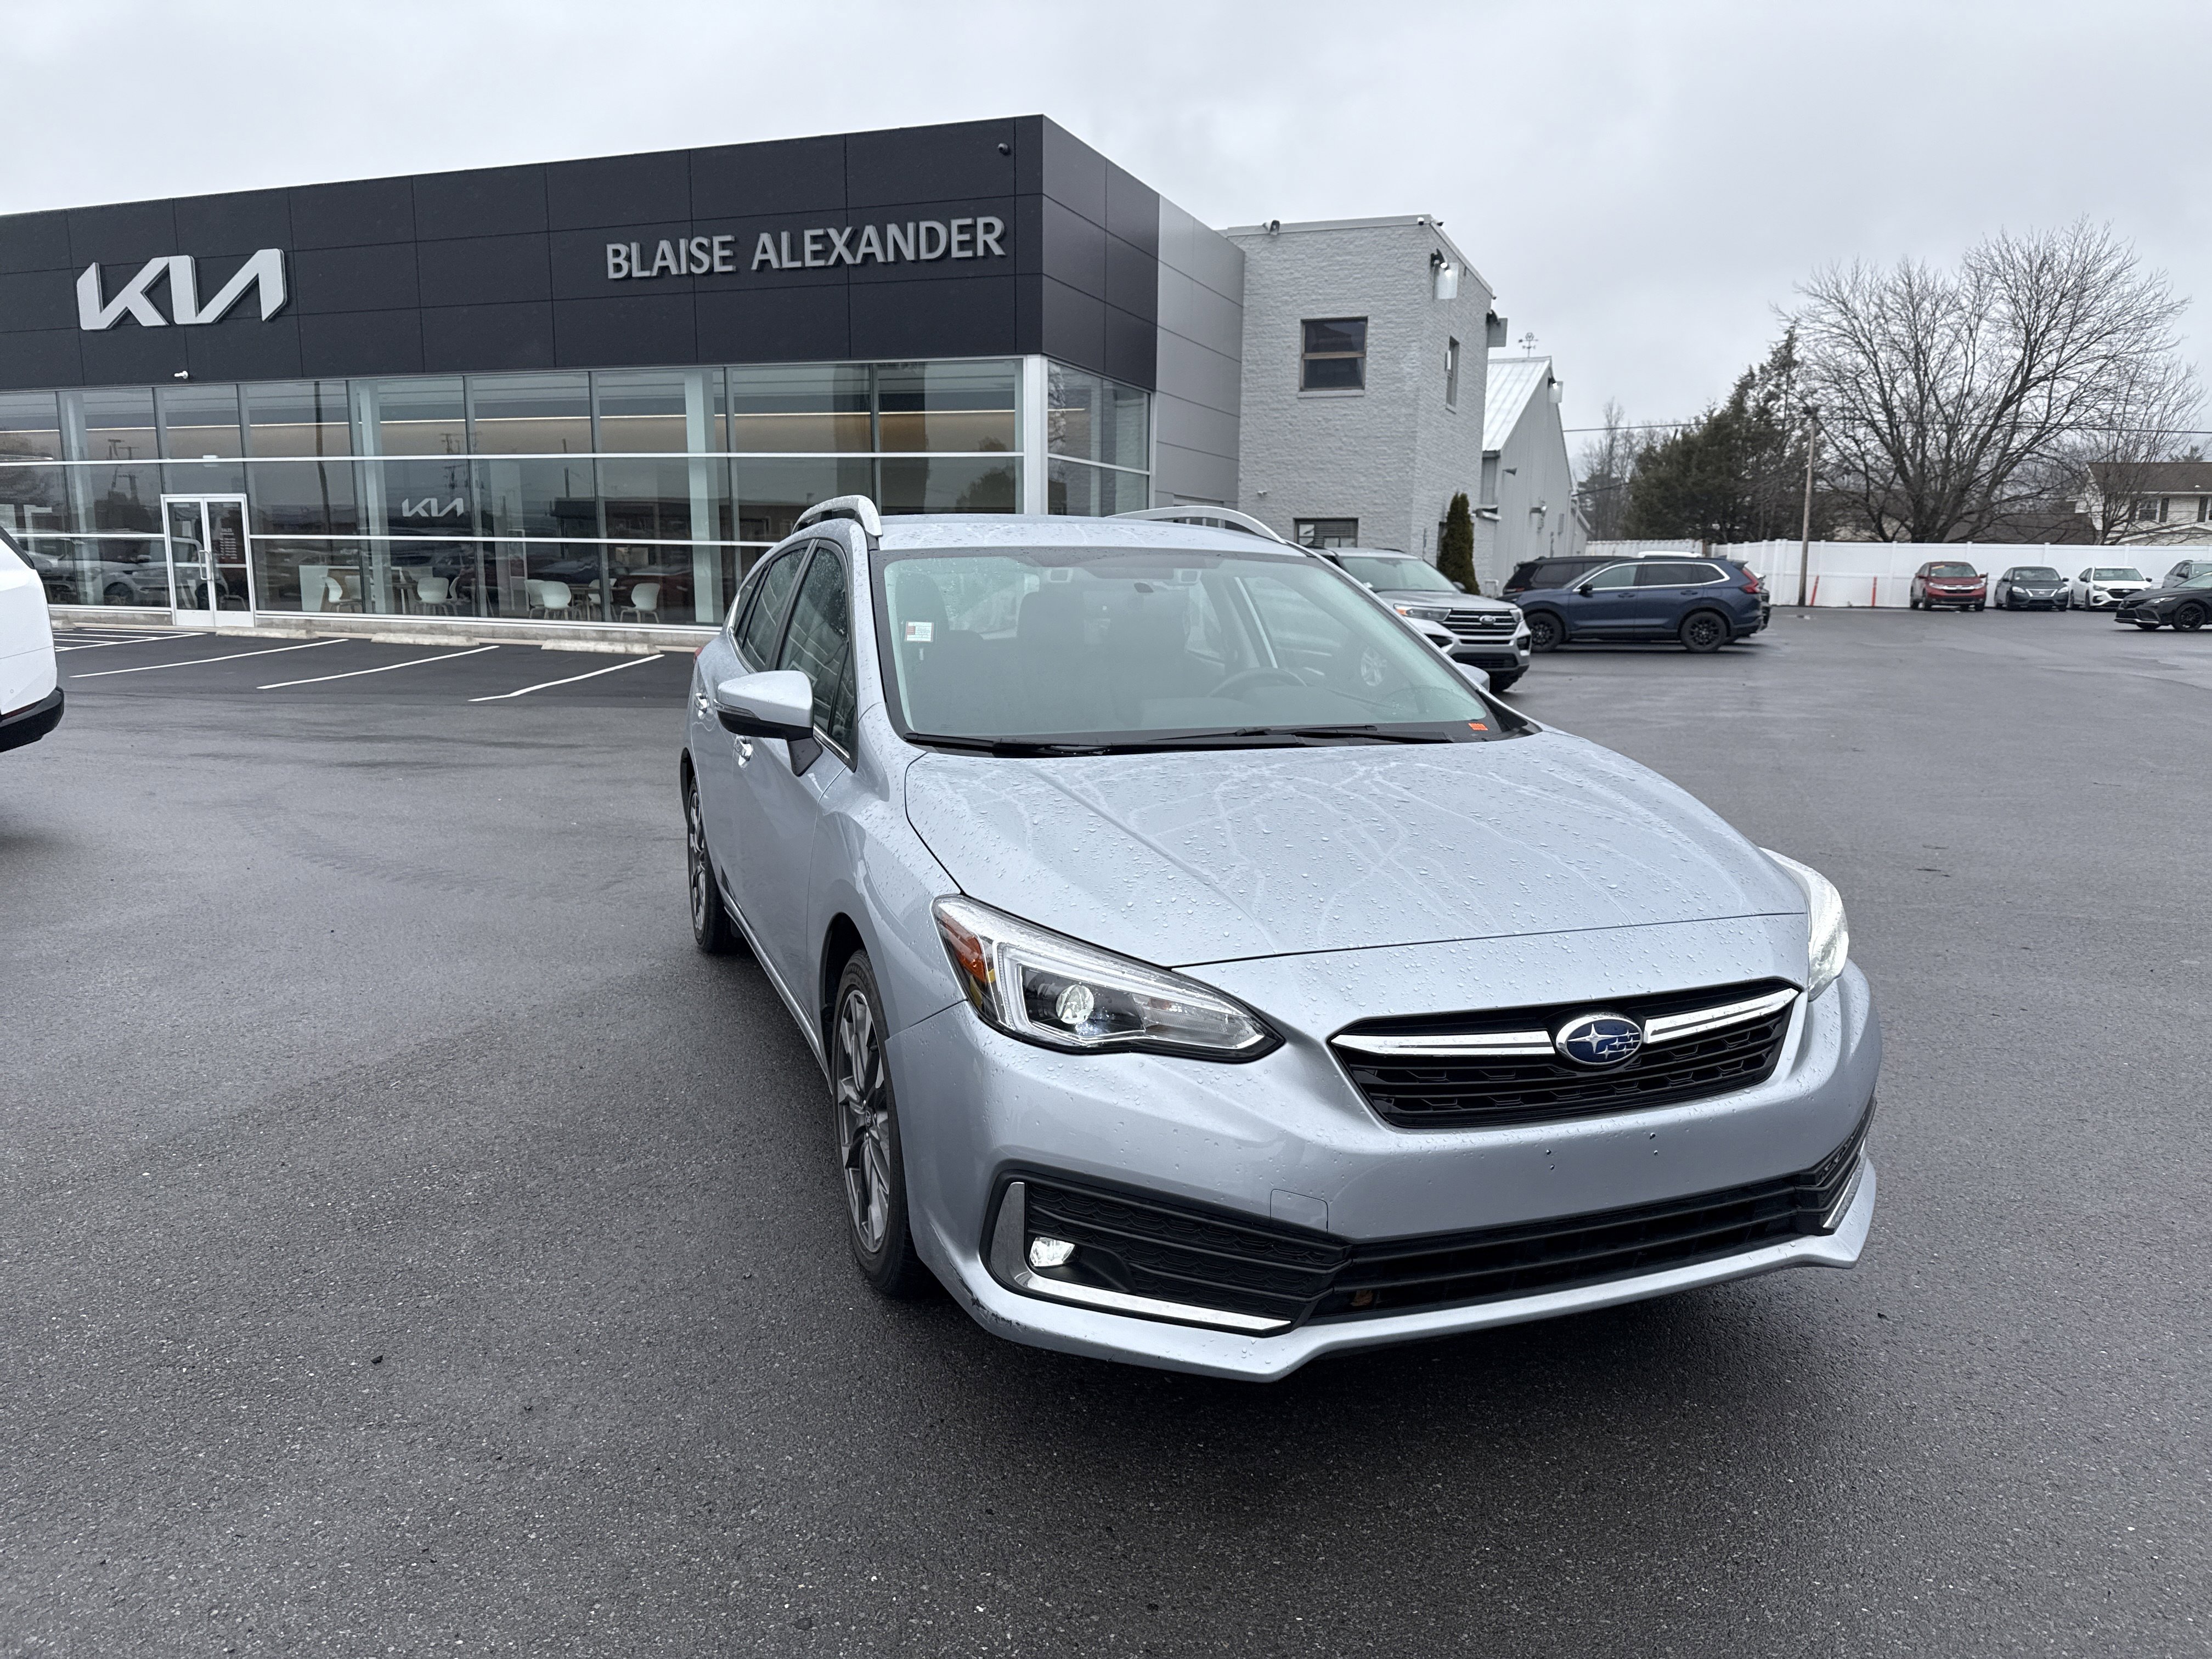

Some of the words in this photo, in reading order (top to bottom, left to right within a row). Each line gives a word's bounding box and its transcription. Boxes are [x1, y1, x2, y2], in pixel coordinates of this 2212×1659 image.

[606, 234, 736, 279] BLAISE
[751, 216, 1006, 270] ALEXANDER
[76, 248, 287, 330] KIA
[401, 497, 464, 517] KIA
